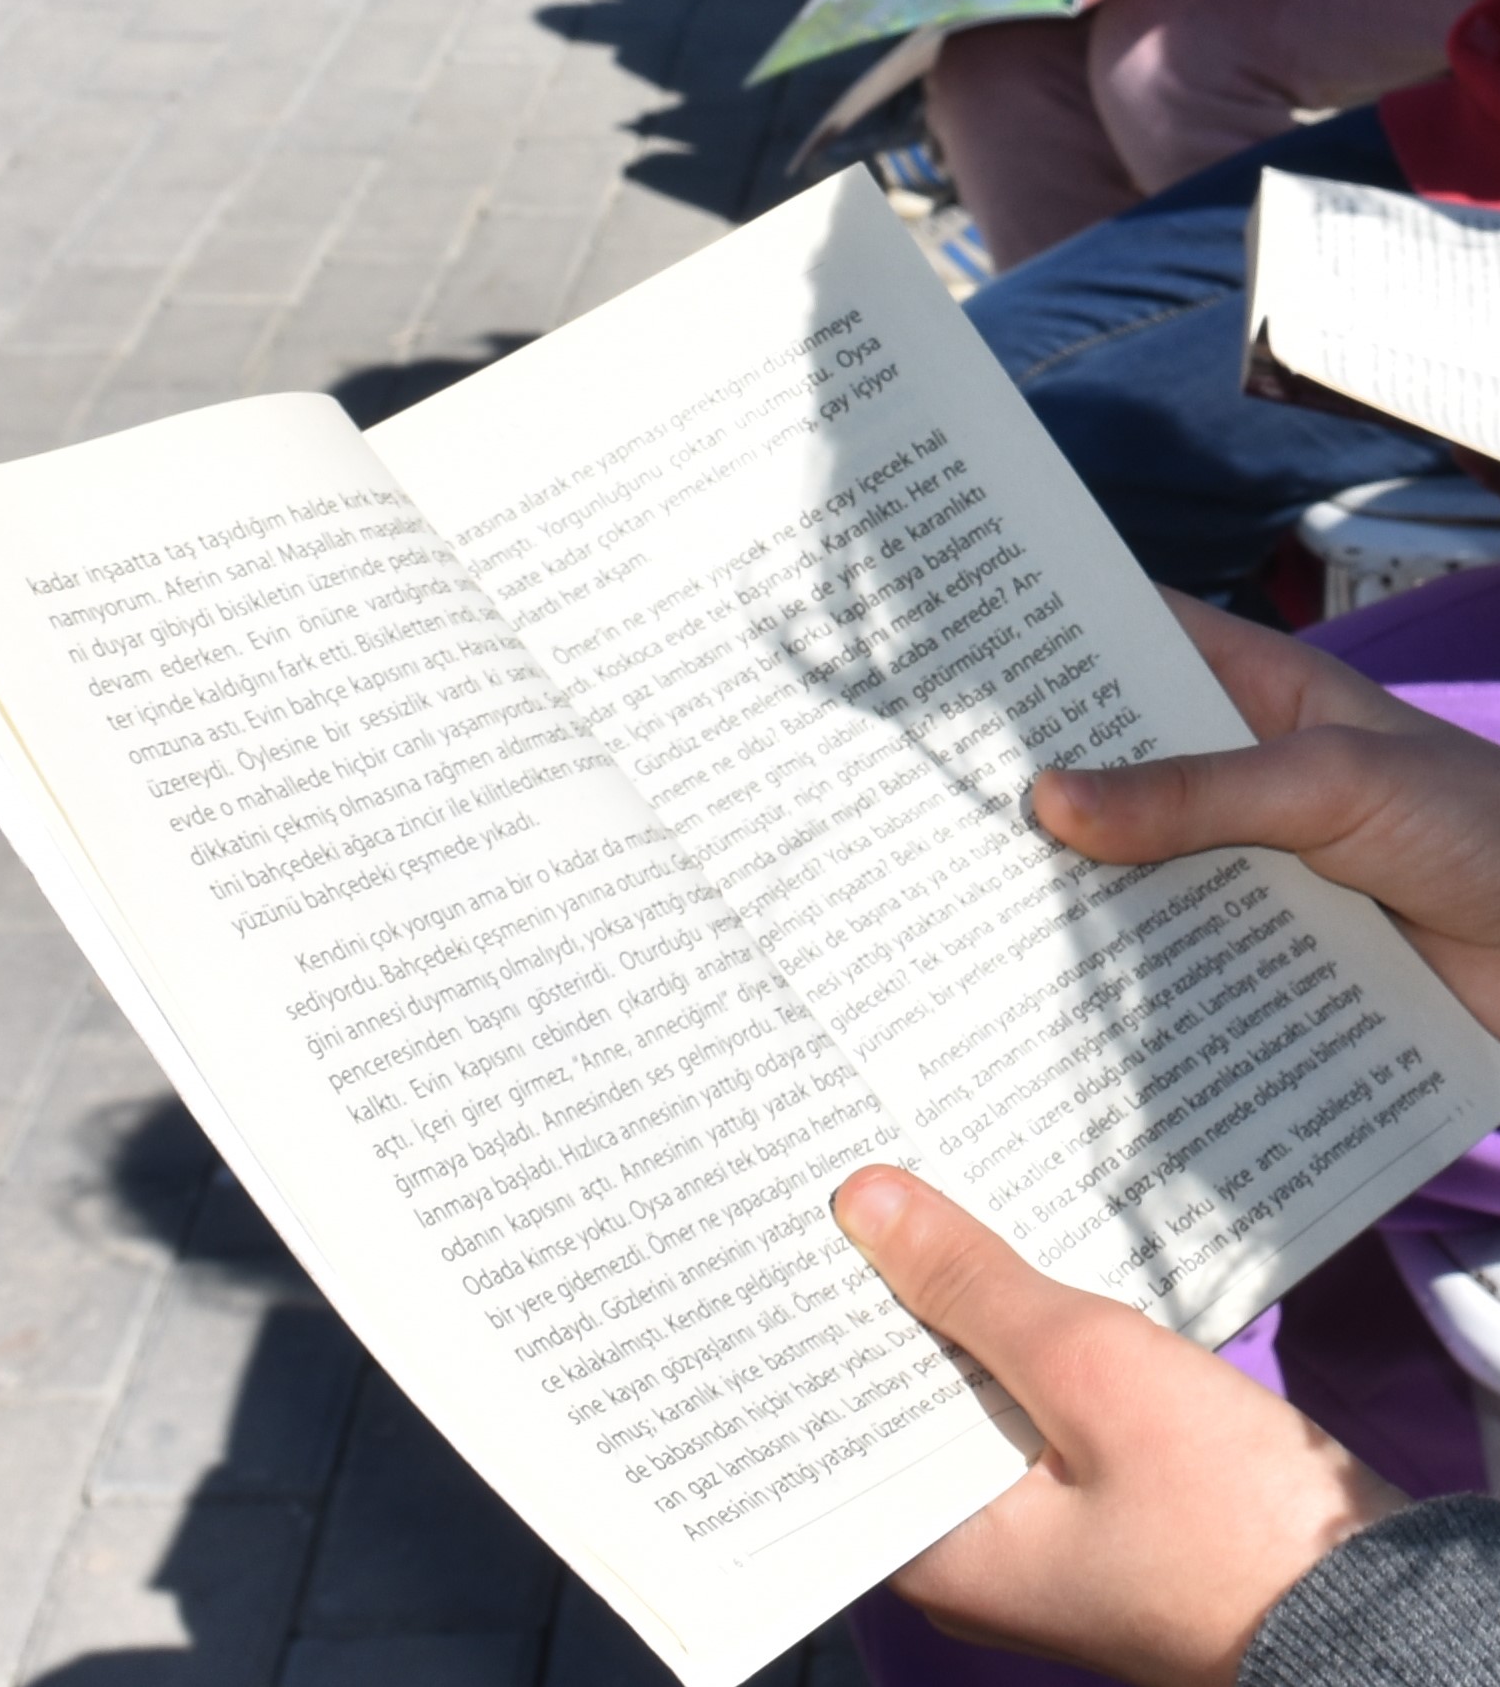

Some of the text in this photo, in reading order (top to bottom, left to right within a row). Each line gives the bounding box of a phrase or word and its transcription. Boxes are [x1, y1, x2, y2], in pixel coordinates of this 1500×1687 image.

[455, 308, 863, 547] arasına alarak ne yapması gerektiğini düşünmeye
[496, 570, 544, 601] saate
[540, 542, 593, 576] kadar
[596, 508, 656, 552] çoktan
[657, 448, 759, 518] yemeklerini
[815, 392, 850, 426] çay
[848, 362, 900, 400] içiyor
[536, 465, 664, 538] Yorgunluğunu
[668, 427, 728, 471] çoktan
[834, 336, 883, 369] Oysa
[24, 570, 82, 596] kadar
[81, 551, 163, 584] inşaatta
[163, 541, 198, 562] taş
[196, 513, 288, 551] taşıdığım
[285, 496, 340, 523] halde
[47, 527, 359, 630] namıyorum. Aferin sana! Maşallah
[67, 642, 90, 665] ni
[91, 631, 146, 659] duyar
[149, 607, 216, 648] gibiydi
[214, 582, 306, 622] bisikletin
[307, 557, 387, 593] üzerinde
[592, 458, 968, 682] Koskoca evde tek başınaydı. Karanlıktı. Her ne
[621, 611, 648, 632] ne
[646, 577, 705, 622] yemek
[705, 539, 772, 589] yiyecek
[771, 524, 798, 545] ne
[798, 507, 827, 530] de
[821, 486, 858, 517] çay
[854, 451, 915, 495] içecek
[910, 427, 949, 460] hali
[87, 576, 453, 698] devam ederken. Evin önüne vardığında
[105, 711, 135, 732] ter
[133, 692, 196, 727] içinde
[192, 669, 279, 706] kaldığını
[275, 652, 319, 681] fark
[318, 639, 358, 667] etti.
[353, 615, 448, 654] Bisikletten
[127, 638, 500, 765] omzuna astı. Evin bahçe kapısını açtı. Hava
[633, 542, 1027, 777] Gündüz evde nelerin yaşandığını merak ediyordu.
[792, 779, 834, 808] niçin
[934, 679, 998, 719] Babası
[1001, 622, 1085, 684] annesinin
[285, 974, 384, 1021] sediyordu.
[378, 935, 473, 985] Bahçedeki
[471, 906, 559, 955] çeşmenin
[555, 881, 617, 922] yanına
[304, 891, 688, 1061] ğini annesi duymamış olmalıydı, yoksa yattığı
[345, 946, 754, 1125] kalktı. Evin kapısını cebinden çıkardığı anahtar
[829, 870, 1070, 1036] gidecekti? Tek başına annesinin
[371, 1133, 415, 1160] açtı.
[410, 1108, 458, 1143] İçeri
[460, 1093, 503, 1127] girer
[507, 1066, 575, 1107] girmez,
[736, 979, 773, 1004] diye
[914, 1084, 975, 1129] dalmış,
[970, 1037, 1039, 1089] zamanın
[1036, 1008, 1075, 1043] nasıl
[962, 932, 1319, 1184] sönmek üzere olduğunu fark etti. Lambayı eline alıp
[461, 1258, 526, 1295] Odada
[519, 1235, 577, 1269] kimse
[575, 1213, 633, 1250] yoktu.
[628, 1191, 675, 1221] Oysa
[672, 1161, 729, 1201] annesi
[725, 1149, 758, 1175] tek
[752, 1126, 812, 1163] başına
[483, 1124, 902, 1330] bir yere gidemezdi. Ömer ne yapacağını bilemez du-
[1164, 1197, 1217, 1237] korku
[1206, 1168, 1255, 1208] iyice
[1254, 1141, 1293, 1173] arttı.
[1367, 1063, 1395, 1086] bir
